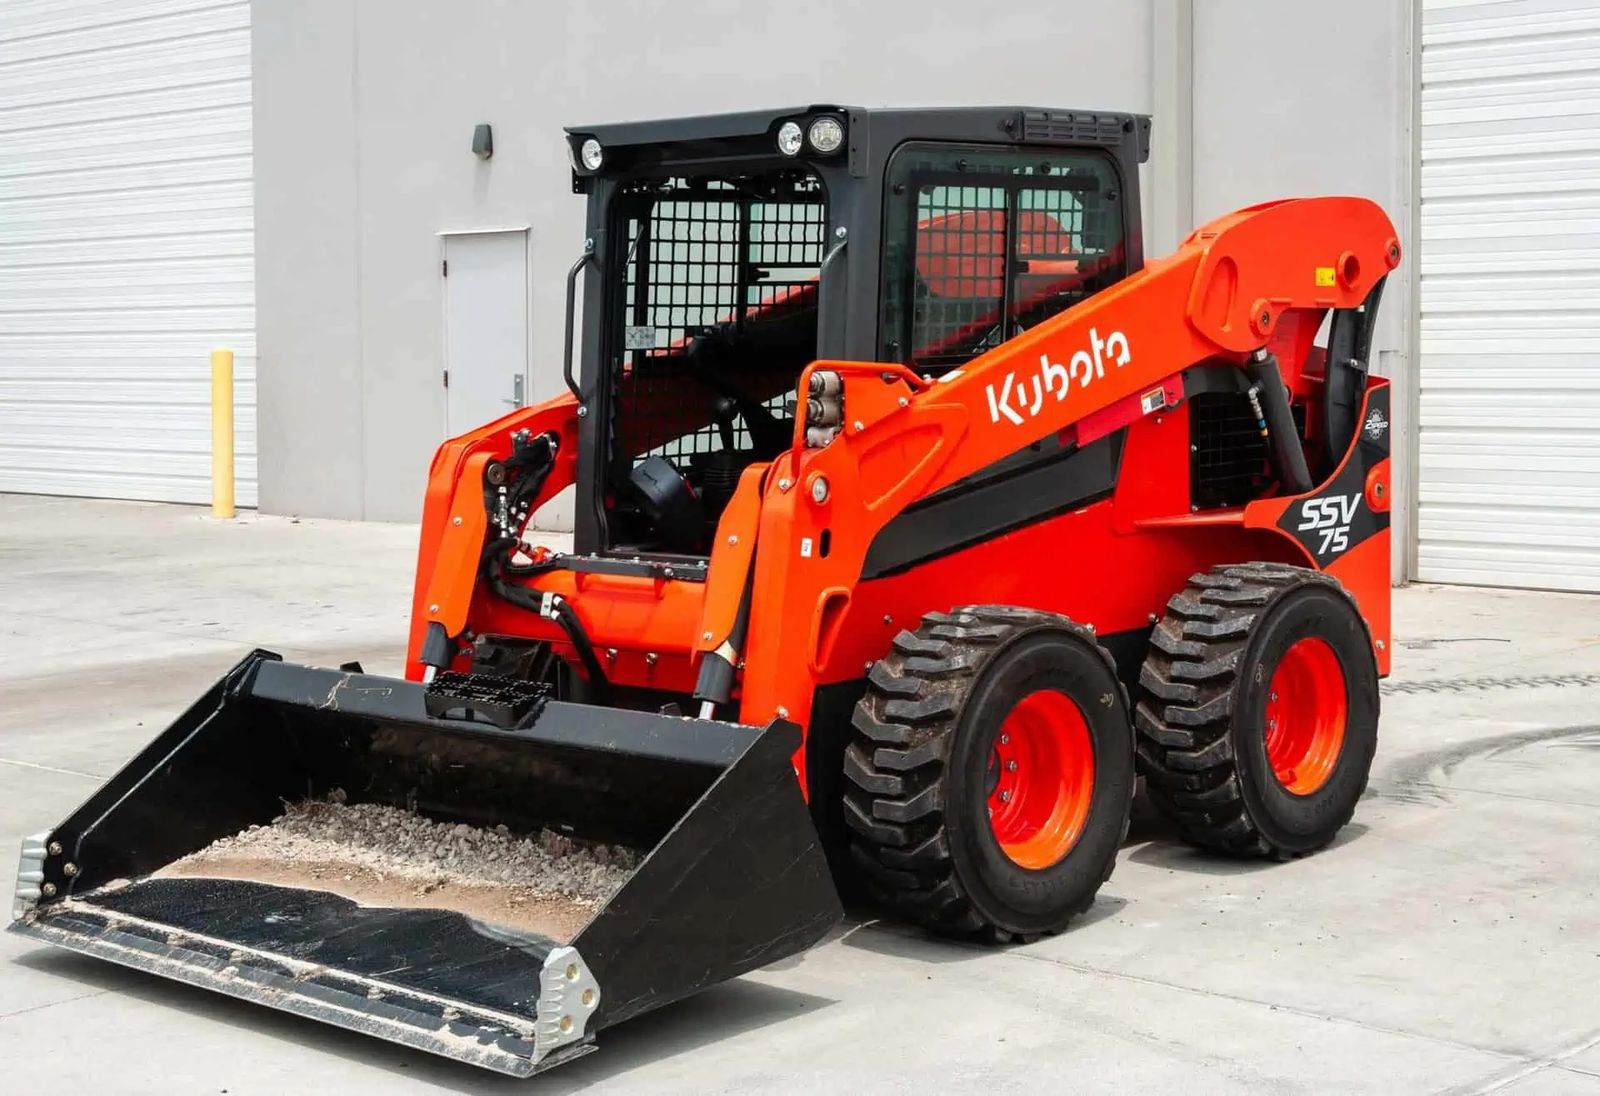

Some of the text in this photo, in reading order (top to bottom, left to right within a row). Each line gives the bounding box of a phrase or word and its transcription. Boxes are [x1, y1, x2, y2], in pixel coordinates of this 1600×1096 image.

[985, 327, 1131, 426] Kubota
[1298, 492, 1362, 531] SSV
[1317, 525, 1350, 555] 75
